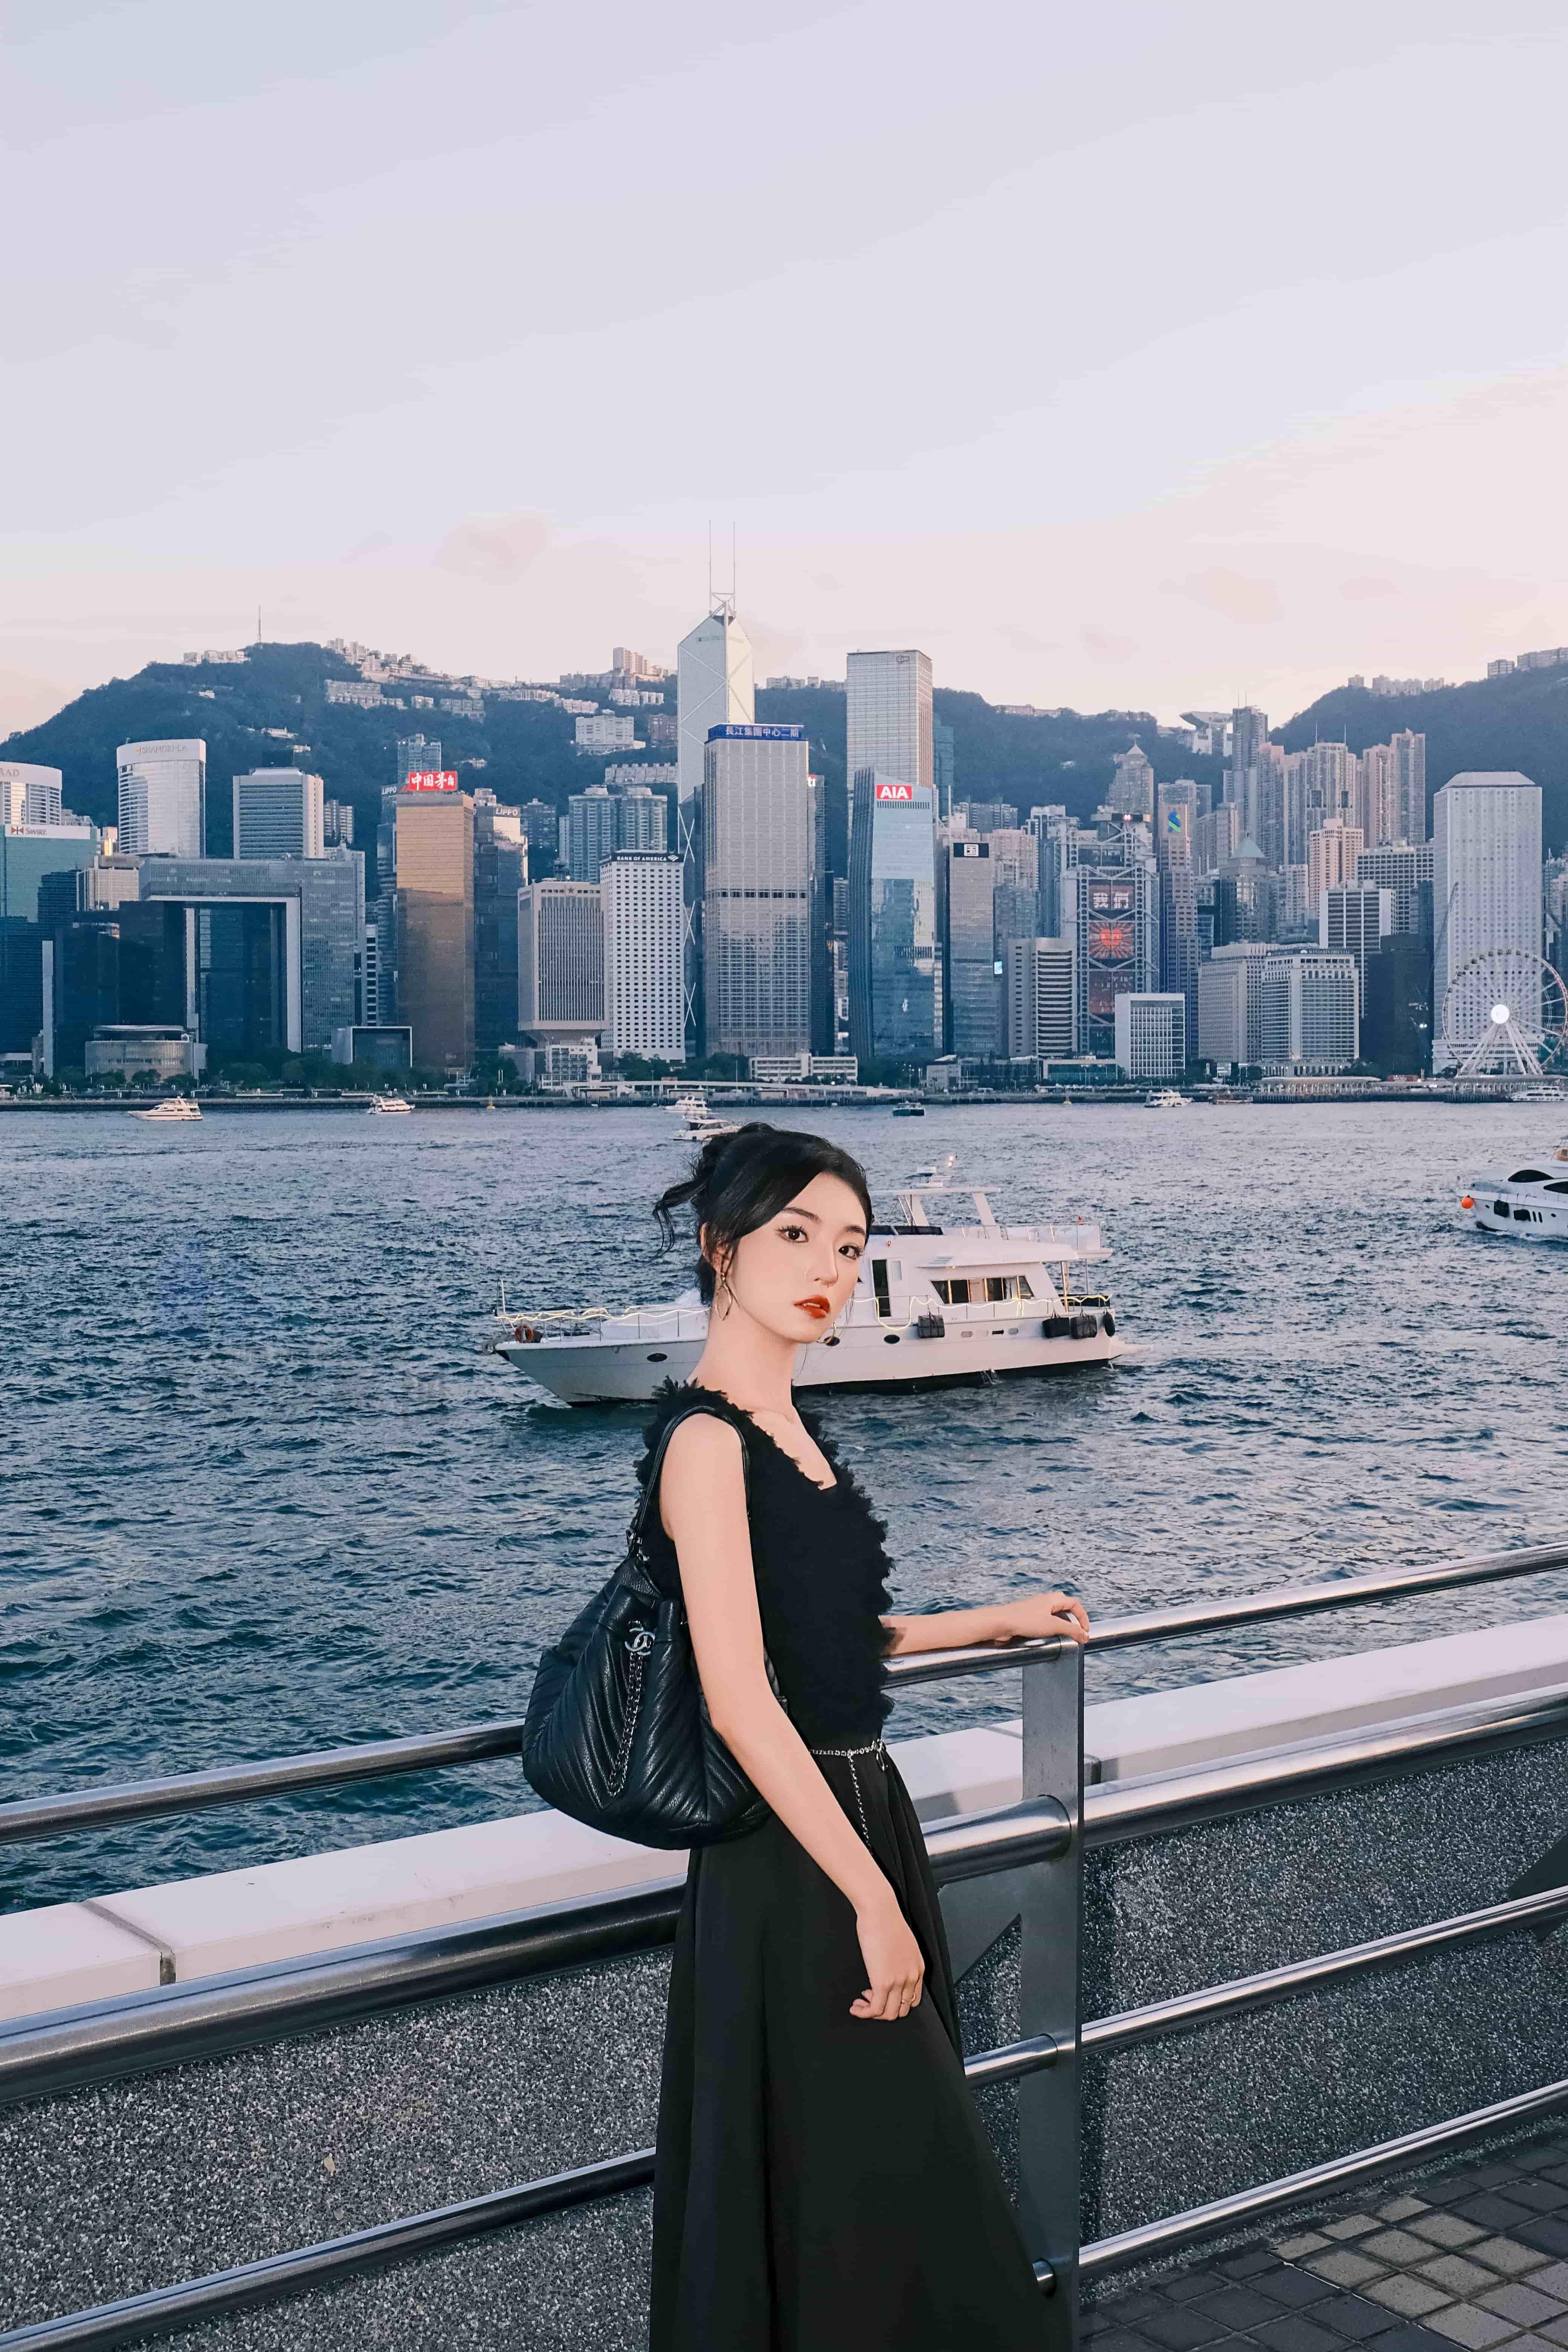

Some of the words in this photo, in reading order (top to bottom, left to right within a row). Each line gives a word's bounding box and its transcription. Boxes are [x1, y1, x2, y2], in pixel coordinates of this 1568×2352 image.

[142, 744, 187, 754] SHANGRI-LA
[382, 787, 397, 795] LIPPO
[880, 786, 909, 798] AIA
[495, 807, 518, 816] LIPPO
[1093, 892, 1129, 909] 我們
